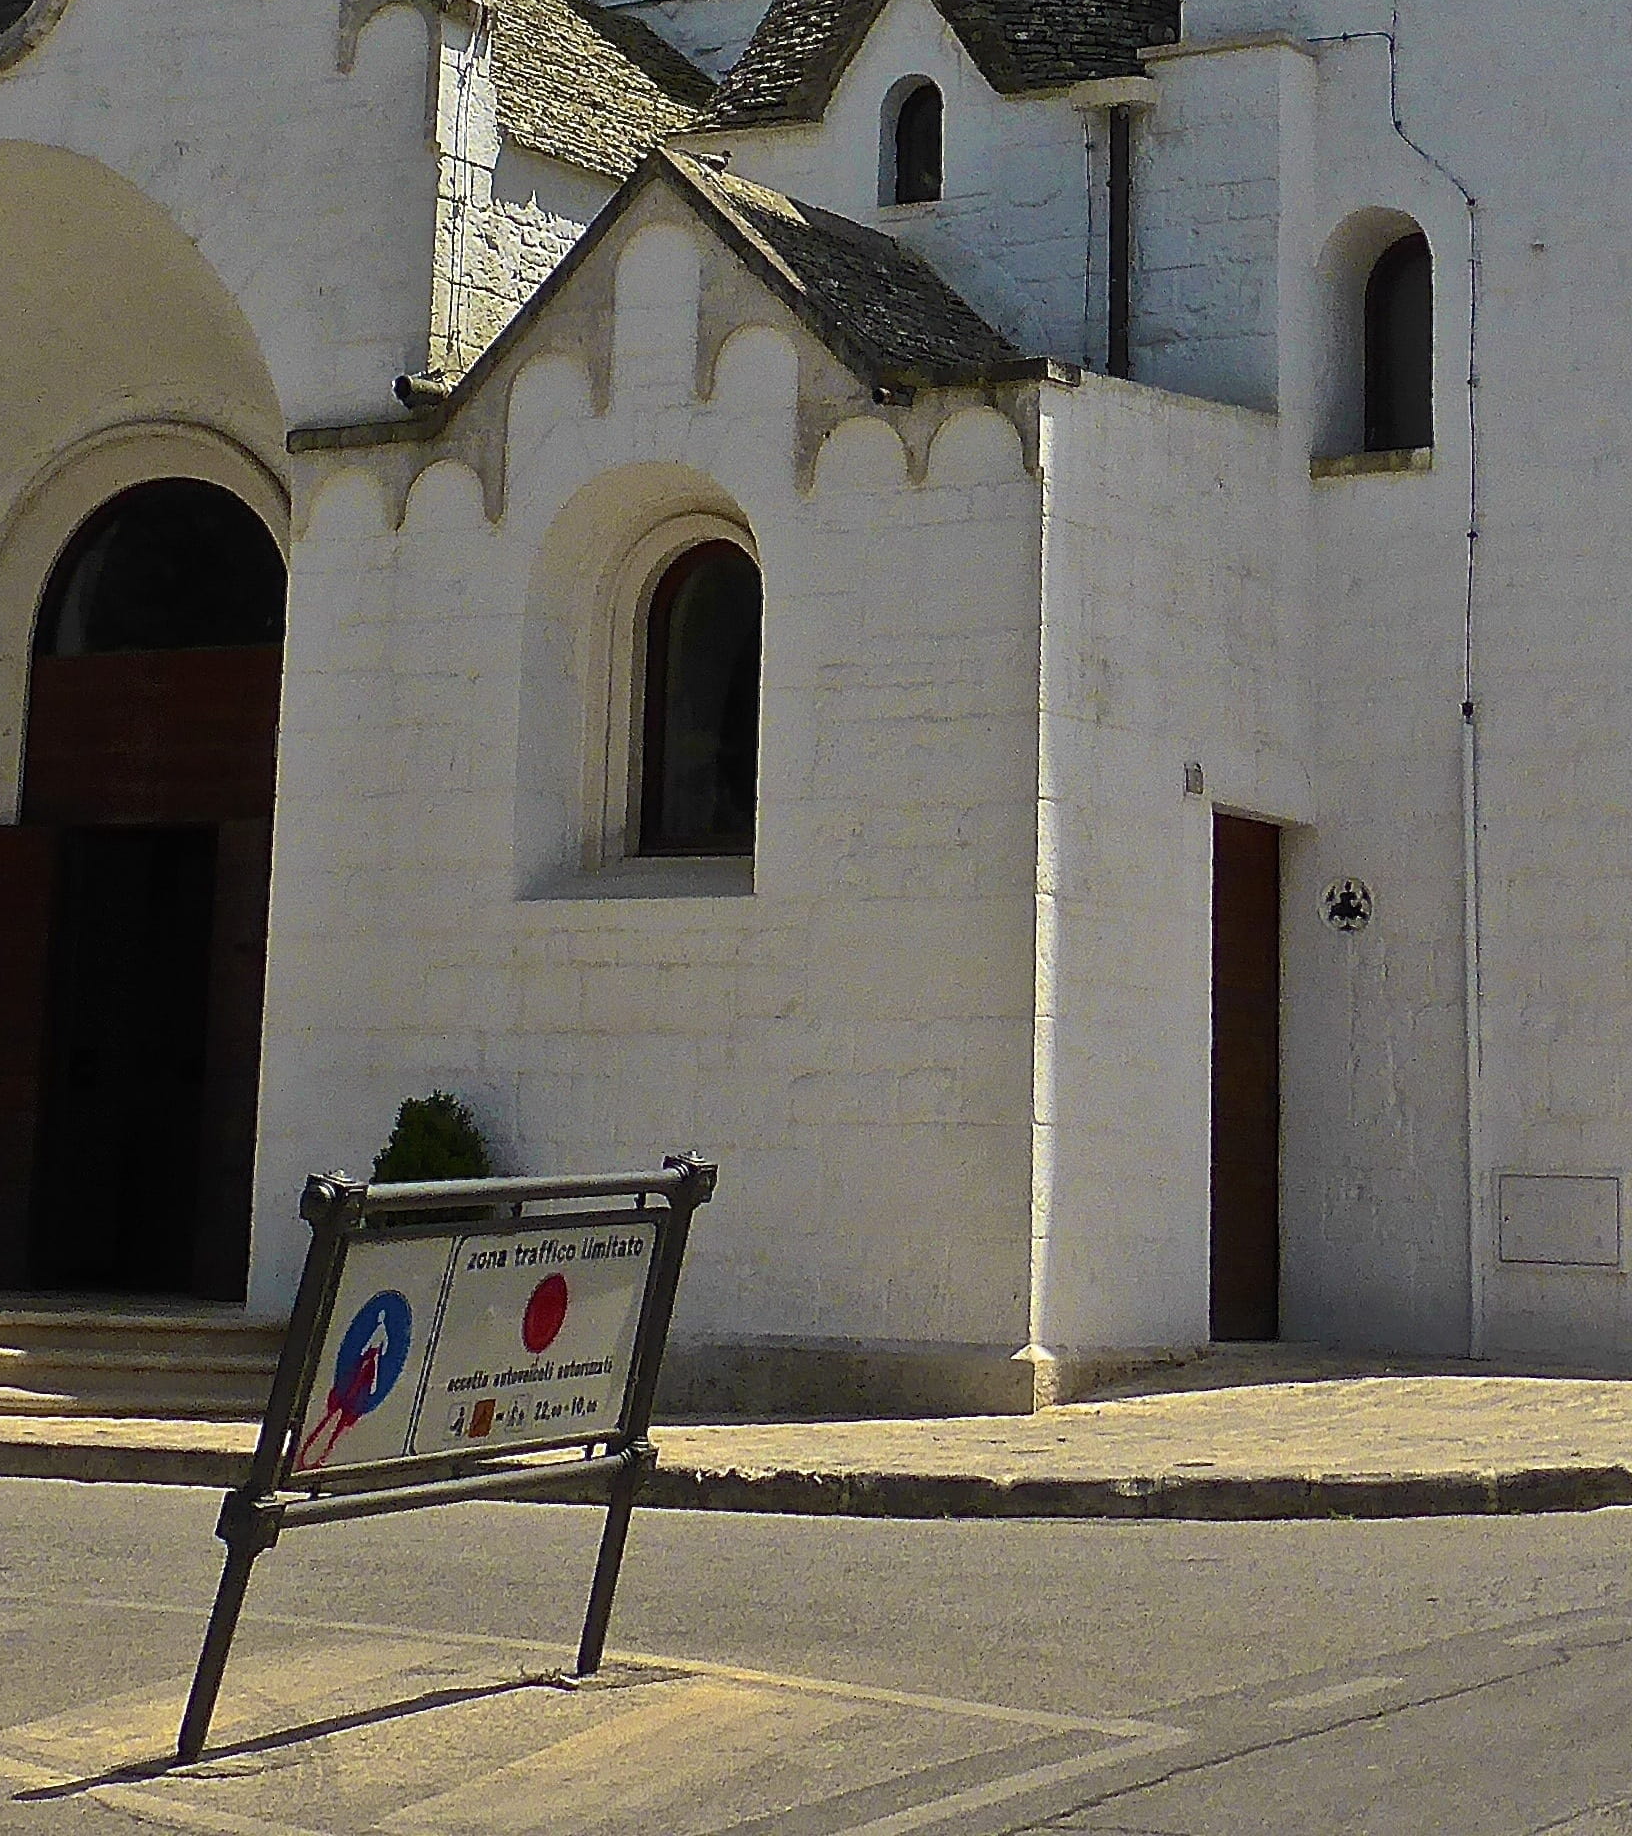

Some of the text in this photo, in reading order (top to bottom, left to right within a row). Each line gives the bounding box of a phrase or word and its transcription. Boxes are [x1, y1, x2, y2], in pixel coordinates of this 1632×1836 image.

[467, 1236, 644, 1271] zona traffico limitato
[447, 1356, 613, 1393] eccetto autoveicoli autorizzati
